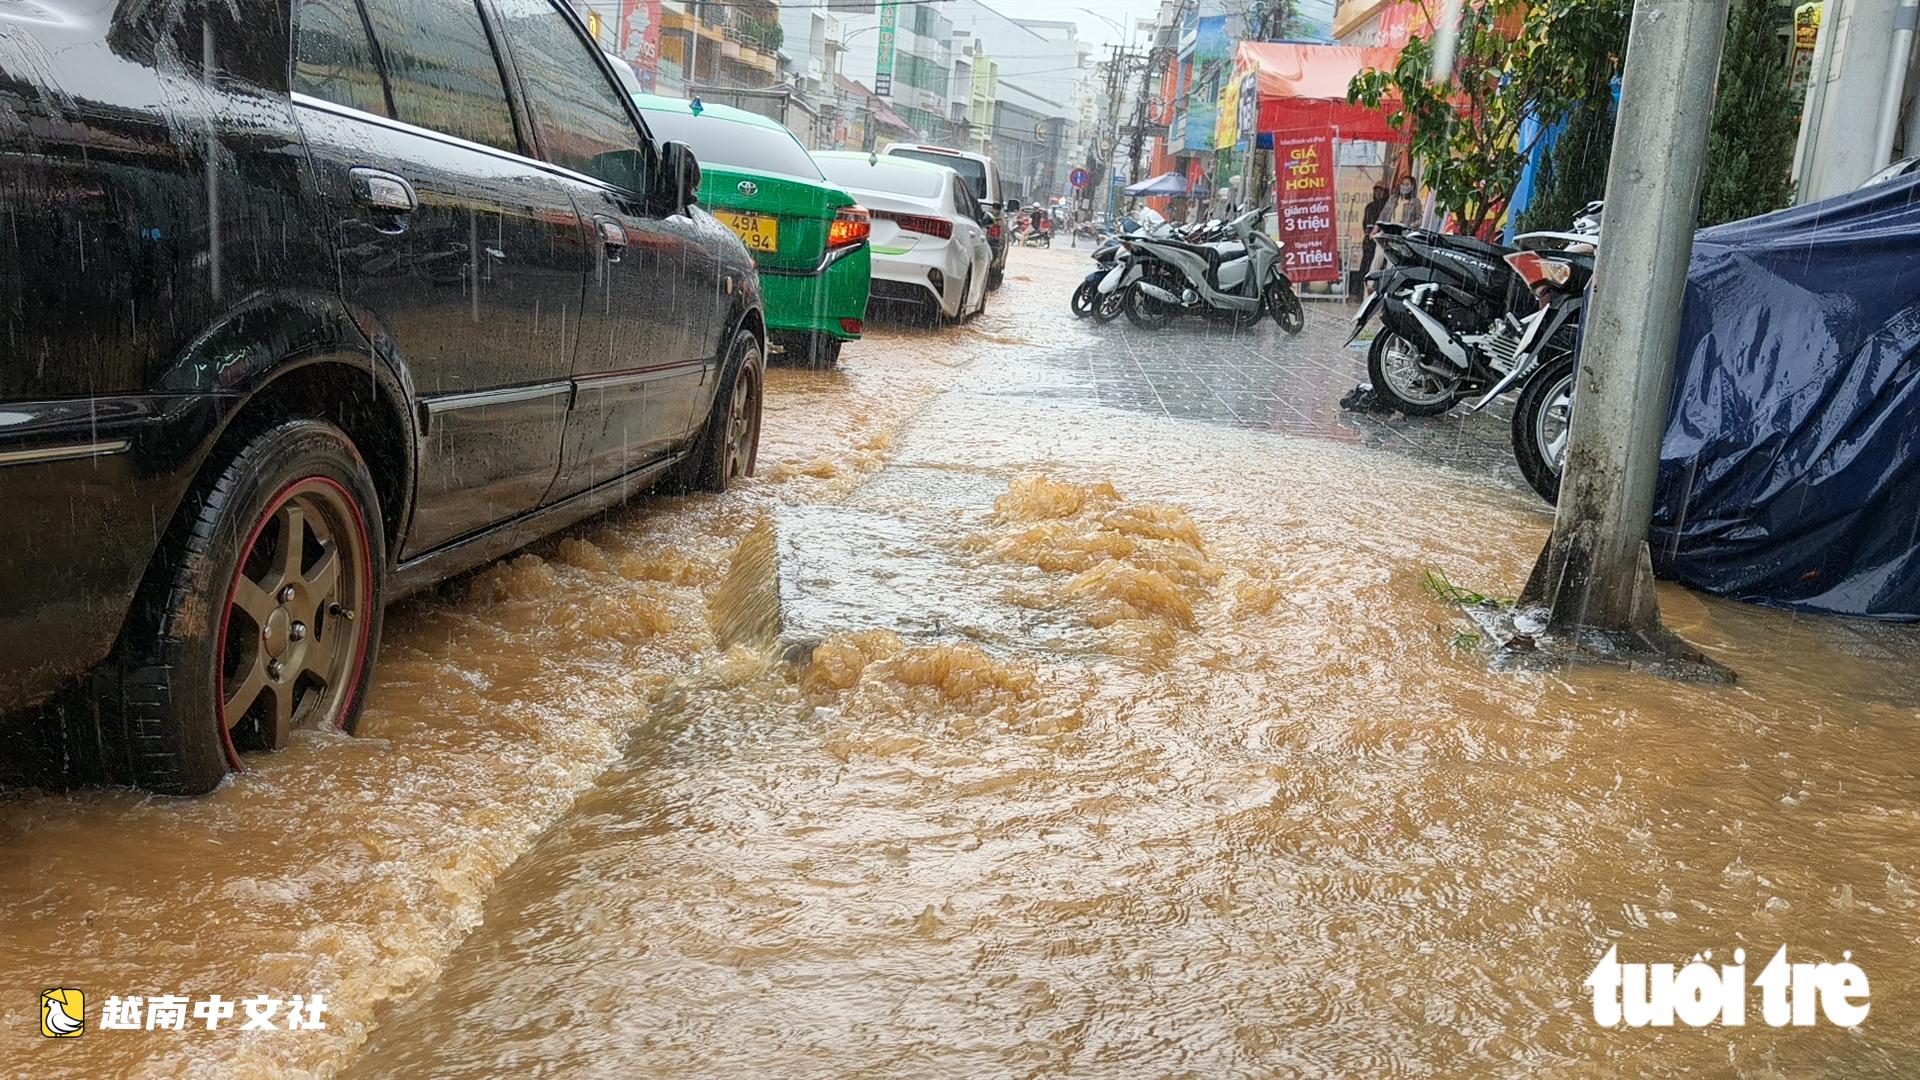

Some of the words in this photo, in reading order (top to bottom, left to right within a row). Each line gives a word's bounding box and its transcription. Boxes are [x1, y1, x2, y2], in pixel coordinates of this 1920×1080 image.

[1290, 145, 1317, 160] GIÁ
[1289, 160, 1319, 176] TỐT
[1286, 177, 1325, 191] HƠN!
[1309, 202, 1329, 214] đến
[731, 216, 758, 232] 49A
[1285, 218, 1295, 231] 3
[1297, 215, 1330, 232] triệu
[1285, 252, 1296, 265] 2
[1297, 249, 1333, 265] Triệu
